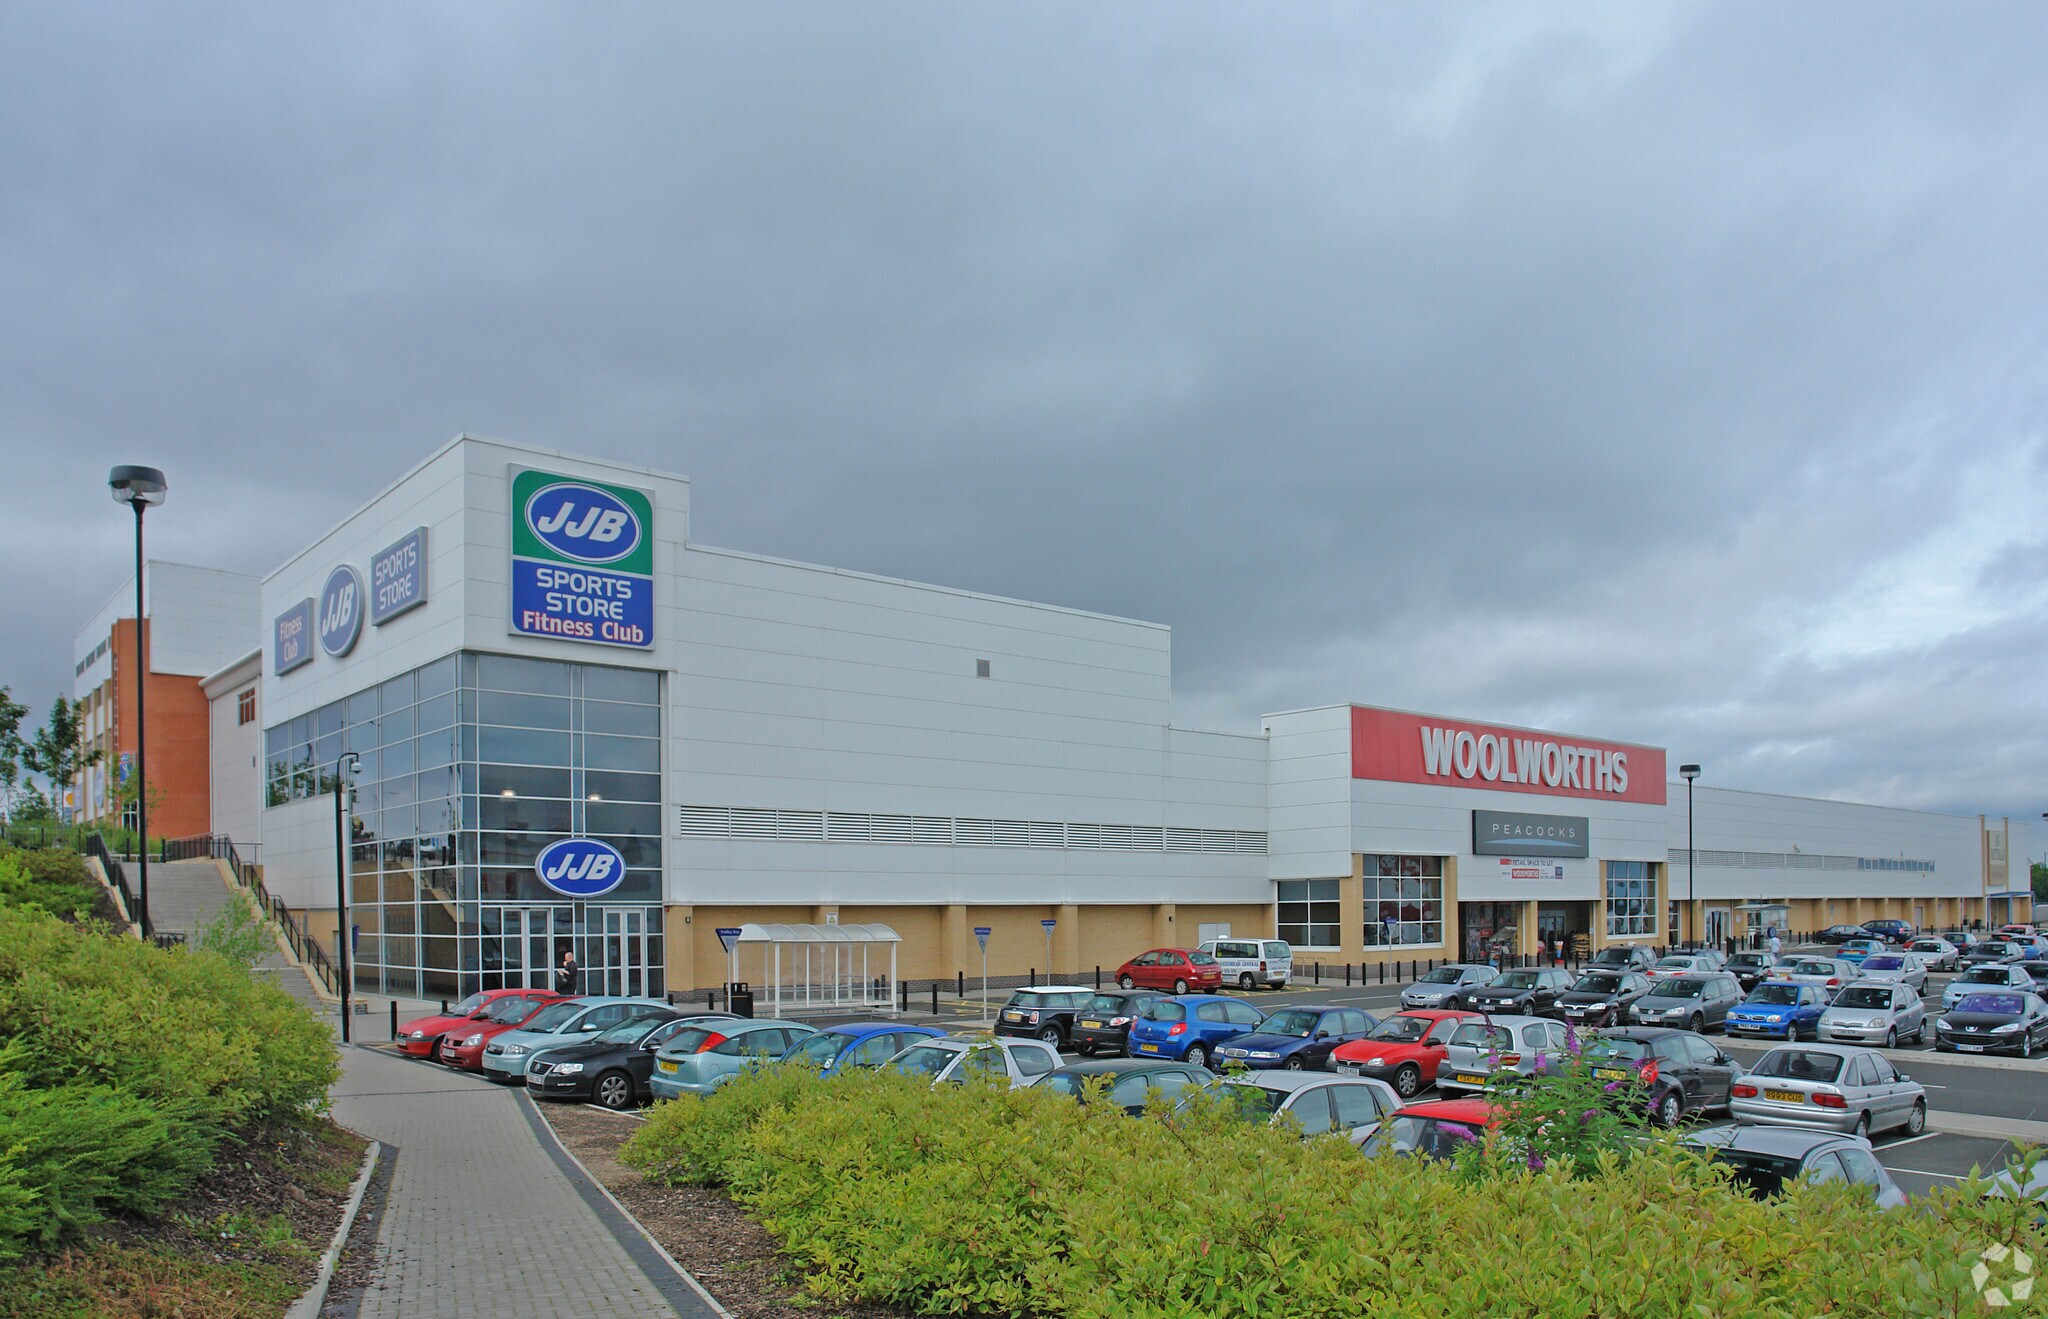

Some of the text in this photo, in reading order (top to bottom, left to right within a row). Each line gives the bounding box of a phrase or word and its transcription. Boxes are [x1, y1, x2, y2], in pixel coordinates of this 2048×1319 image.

[537, 501, 628, 542] JJB
[375, 541, 417, 586] SPORTS
[379, 573, 412, 610] STORE
[536, 567, 633, 600] SPORTS
[321, 582, 355, 637] JJB
[545, 591, 624, 620] STORE
[280, 615, 302, 642] Fitness
[523, 610, 645, 643] Fitness Club
[283, 637, 299, 662] Club
[1420, 725, 1629, 794] WOOLWORTHS
[1492, 823, 1576, 838] PEACOCKS
[546, 853, 616, 880] JJB
[1765, 1090, 1803, 1102] R993 CUS
